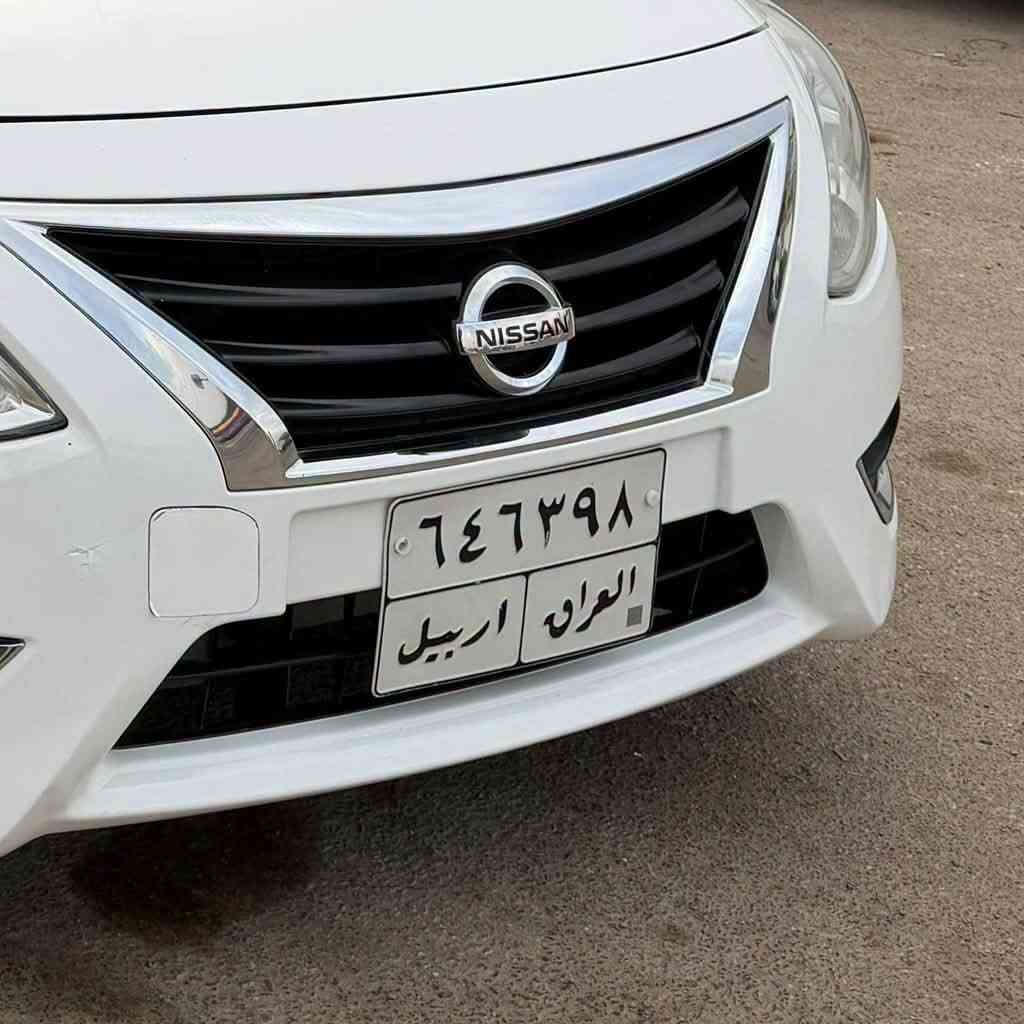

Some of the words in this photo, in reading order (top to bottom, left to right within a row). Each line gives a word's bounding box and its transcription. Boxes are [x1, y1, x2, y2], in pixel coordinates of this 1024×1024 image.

[476, 317, 569, 347] NISSAN
[419, 480, 633, 568] ٦٤٦٣٩٨
[397, 598, 508, 666] اربيل
[544, 566, 637, 639] العراق
